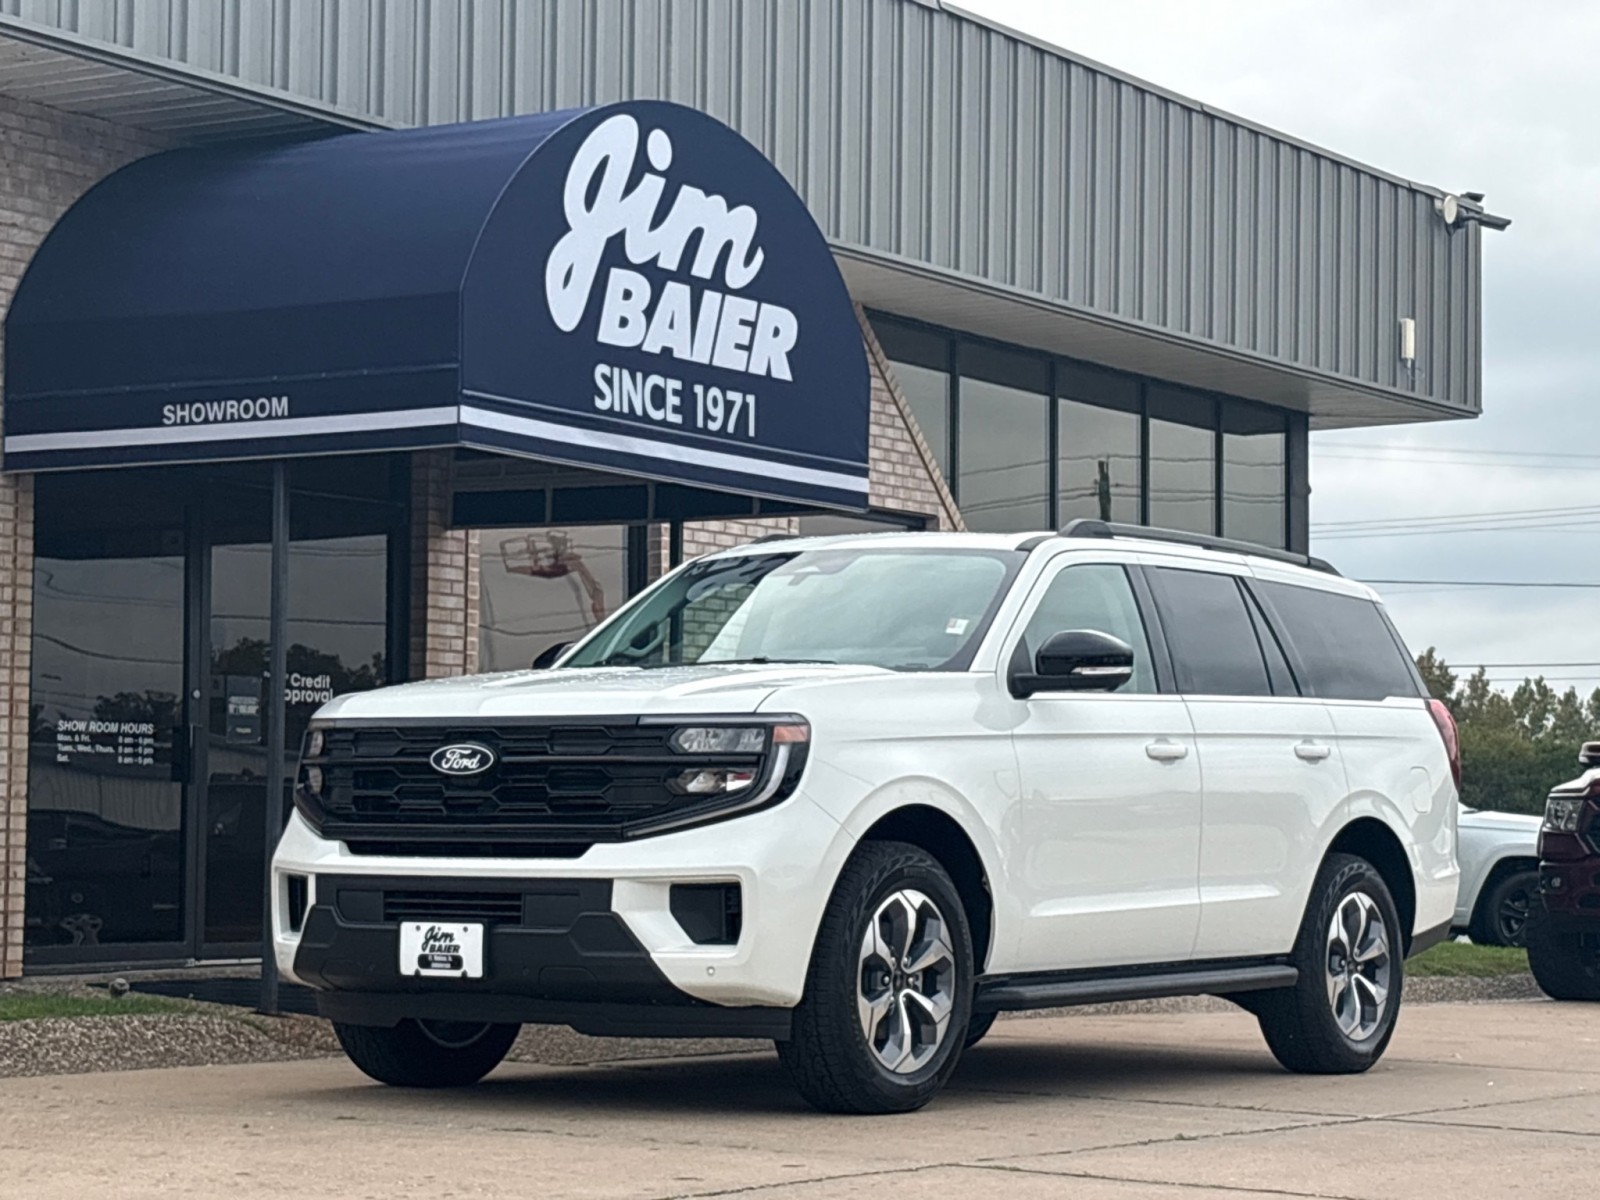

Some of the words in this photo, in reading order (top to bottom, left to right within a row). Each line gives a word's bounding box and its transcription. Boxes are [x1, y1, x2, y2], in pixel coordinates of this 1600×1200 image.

[546, 114, 764, 332] Jim
[597, 267, 799, 382] BAIER
[163, 396, 289, 424] SHOWROOM
[594, 363, 683, 424] SINCE
[693, 384, 756, 437] 1971
[291, 673, 331, 688] Credit
[284, 688, 334, 705] pproval
[57, 720, 88, 732] SHOW
[89, 721, 119, 733] ROOM
[120, 722, 154, 735] HOURS
[441, 748, 481, 769] Ford
[421, 925, 455, 953] Jim
[429, 944, 461, 954] BAIER
